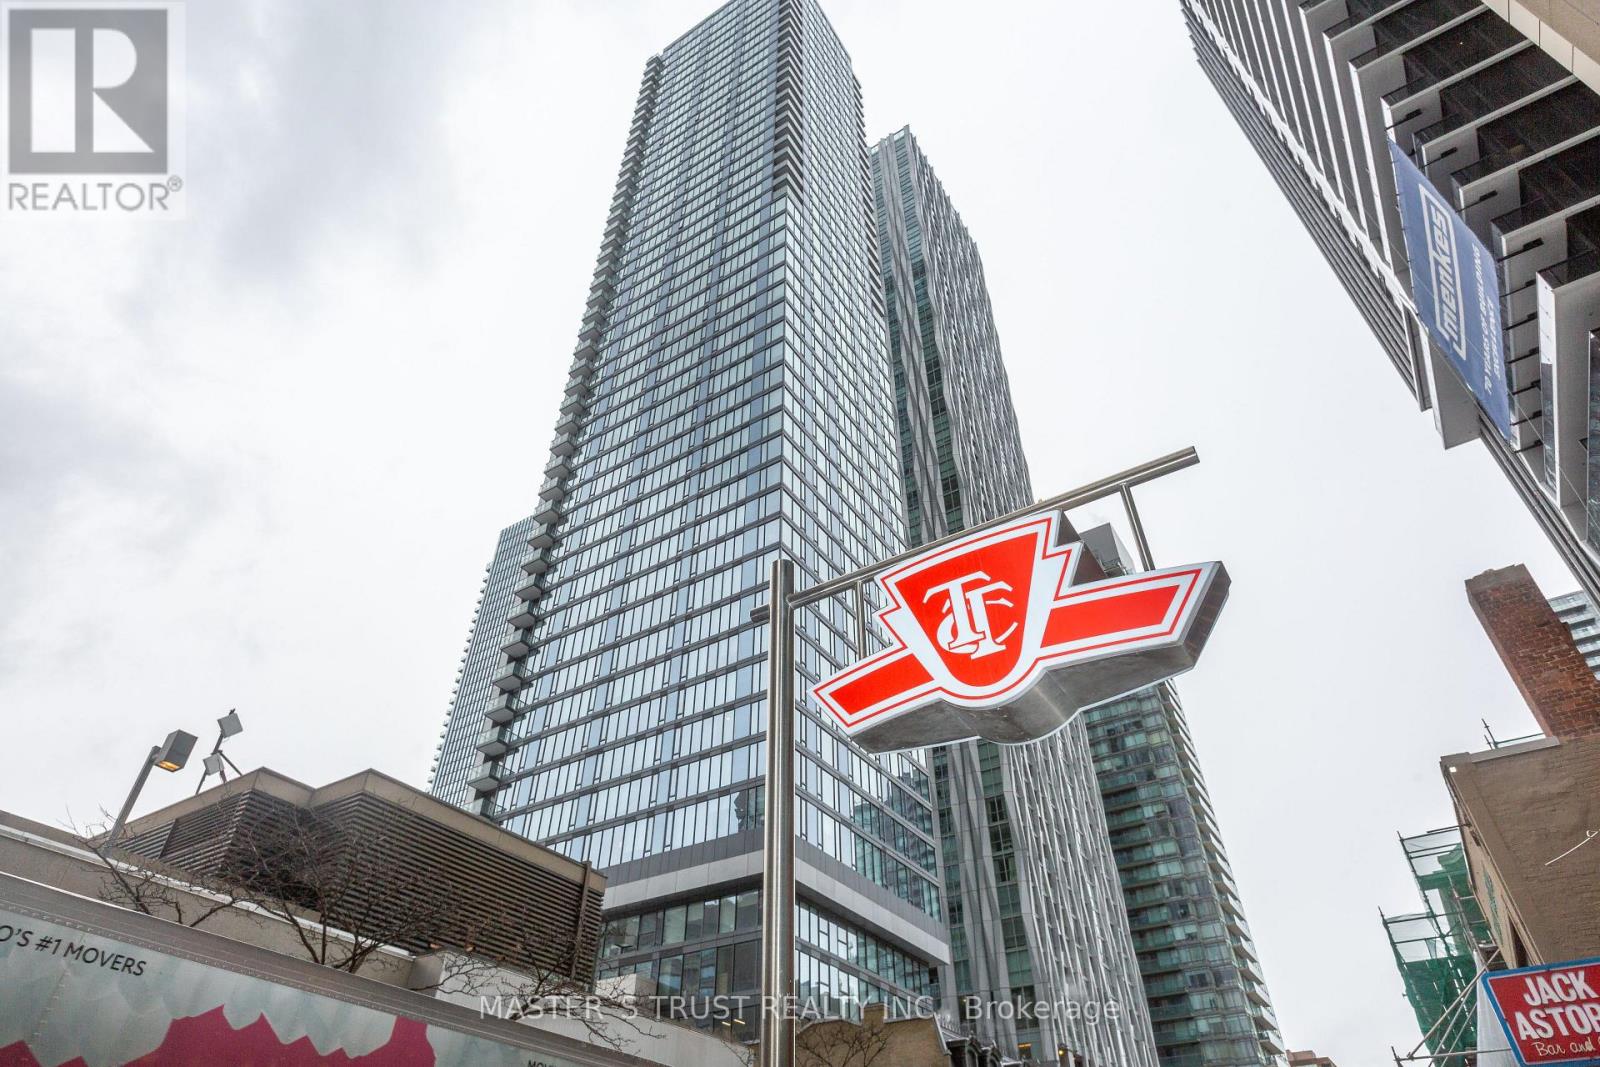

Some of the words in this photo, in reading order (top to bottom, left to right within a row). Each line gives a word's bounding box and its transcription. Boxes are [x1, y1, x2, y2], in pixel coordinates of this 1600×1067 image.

[1430, 203, 1459, 343] menkes
[1471, 243, 1487, 317] BUILDING
[1480, 313, 1489, 336] OF
[1482, 334, 1492, 377] YEARS
[35, 936, 62, 955] #1
[63, 942, 147, 976] MOVERS
[1523, 970, 1600, 1007] JACK
[1531, 1041, 1567, 1056] Bar
[1569, 1036, 1598, 1054] and
